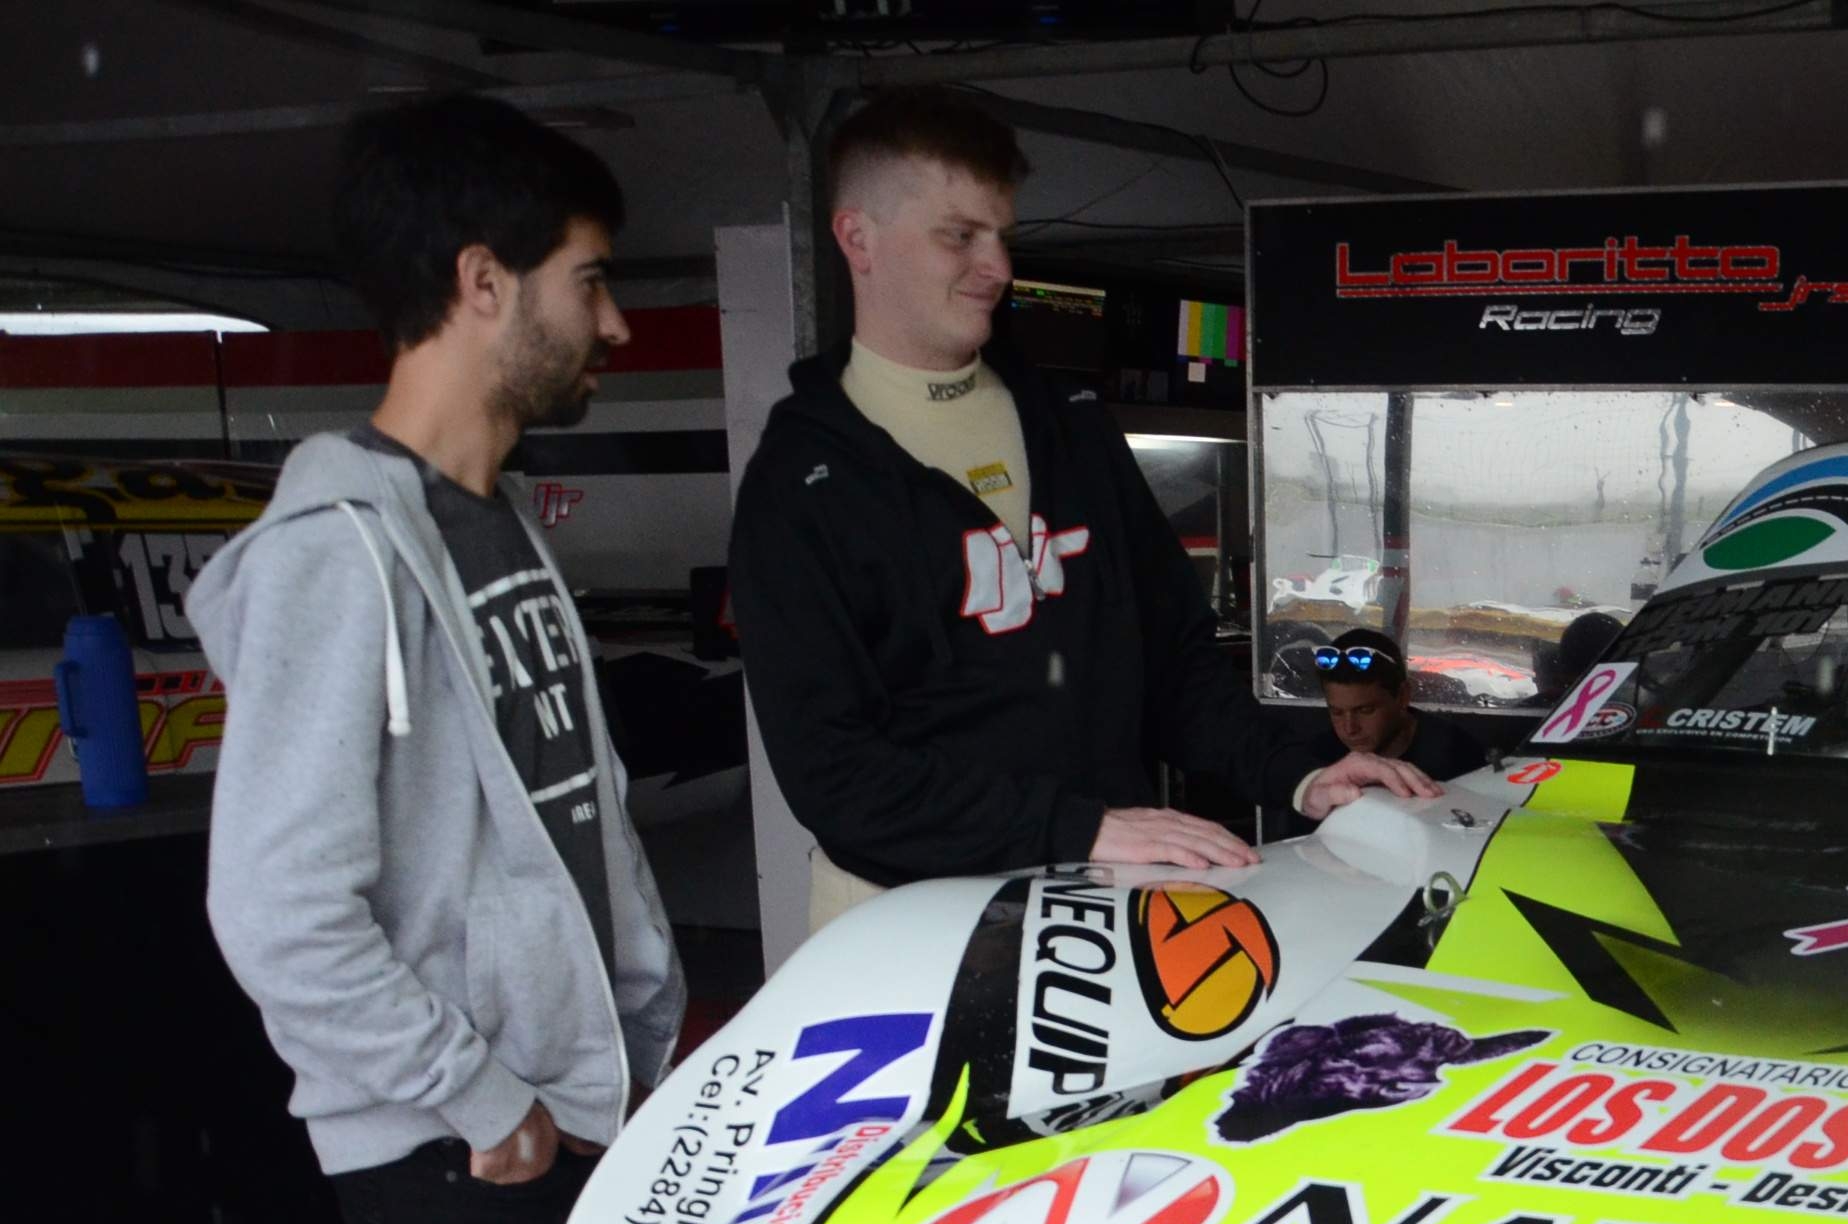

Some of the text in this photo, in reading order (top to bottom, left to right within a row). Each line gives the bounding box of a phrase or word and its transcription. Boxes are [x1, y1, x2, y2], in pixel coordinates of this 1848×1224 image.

[1479, 304, 1662, 335] Racing
[1666, 707, 1817, 736] CRISTEM
[734, 1049, 776, 1107] Av.
[1449, 1063, 1655, 1146] LOS
[1487, 1145, 1704, 1196] Visconti
